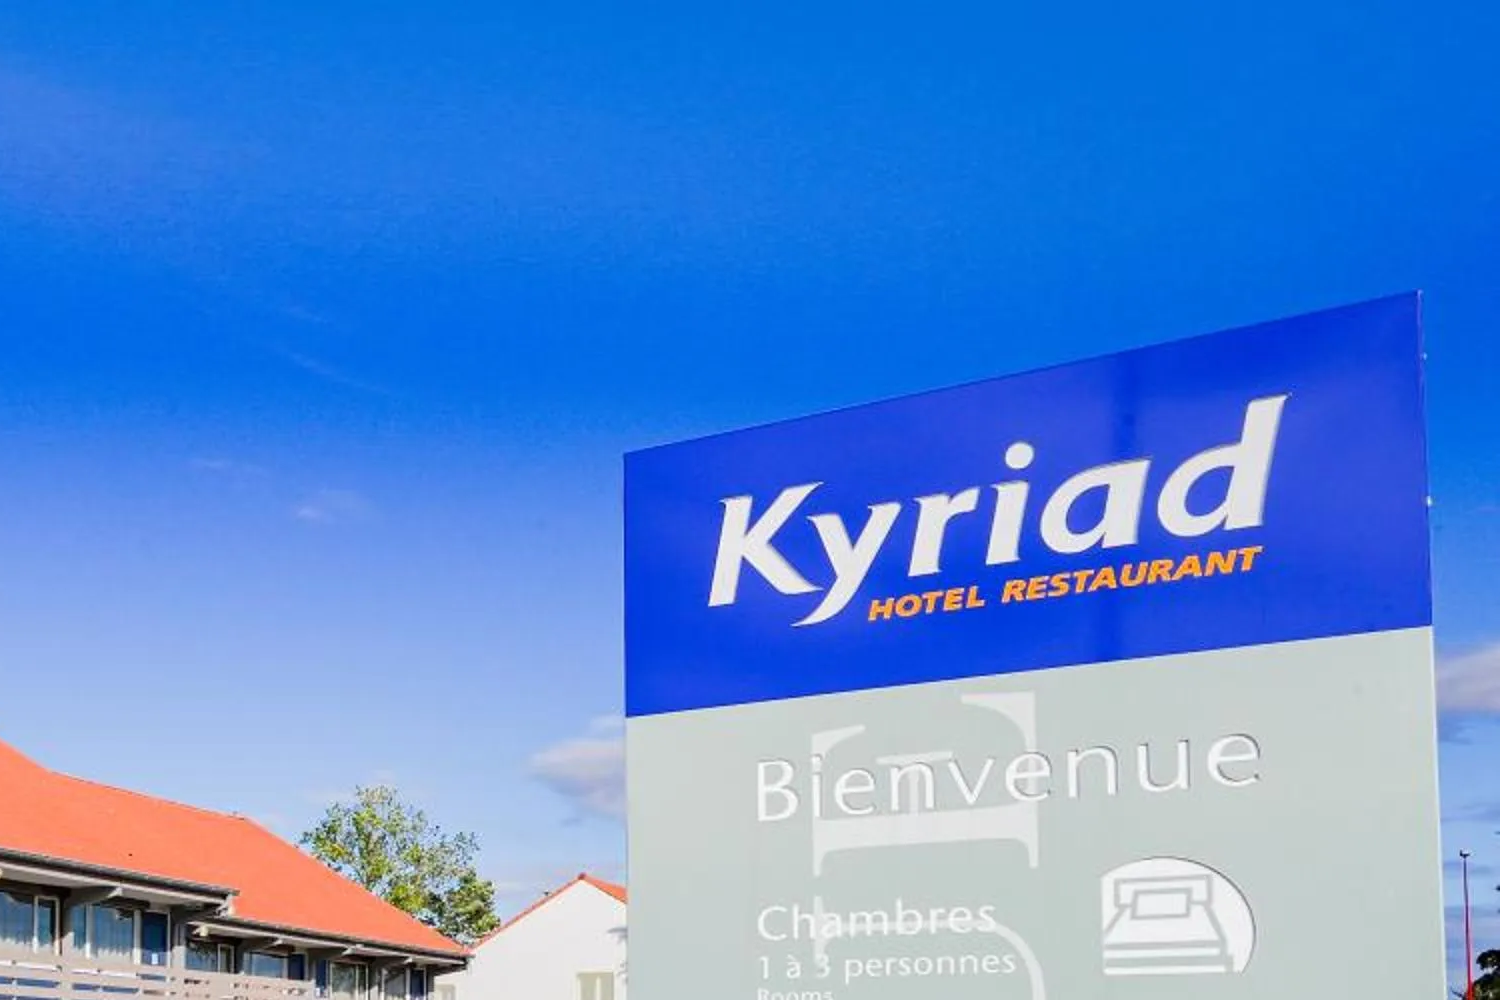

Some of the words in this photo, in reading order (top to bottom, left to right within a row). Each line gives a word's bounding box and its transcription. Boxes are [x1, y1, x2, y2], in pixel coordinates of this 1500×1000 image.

[708, 392, 1290, 627] Kyriad
[867, 583, 985, 622] HOTEL
[1001, 544, 1265, 605] RESTAURANT
[755, 731, 1263, 823] Bienvenue
[757, 897, 998, 942] Chambres
[759, 955, 771, 980] 1
[785, 953, 802, 980] à
[814, 952, 832, 979] 3
[844, 950, 1017, 986] personnes
